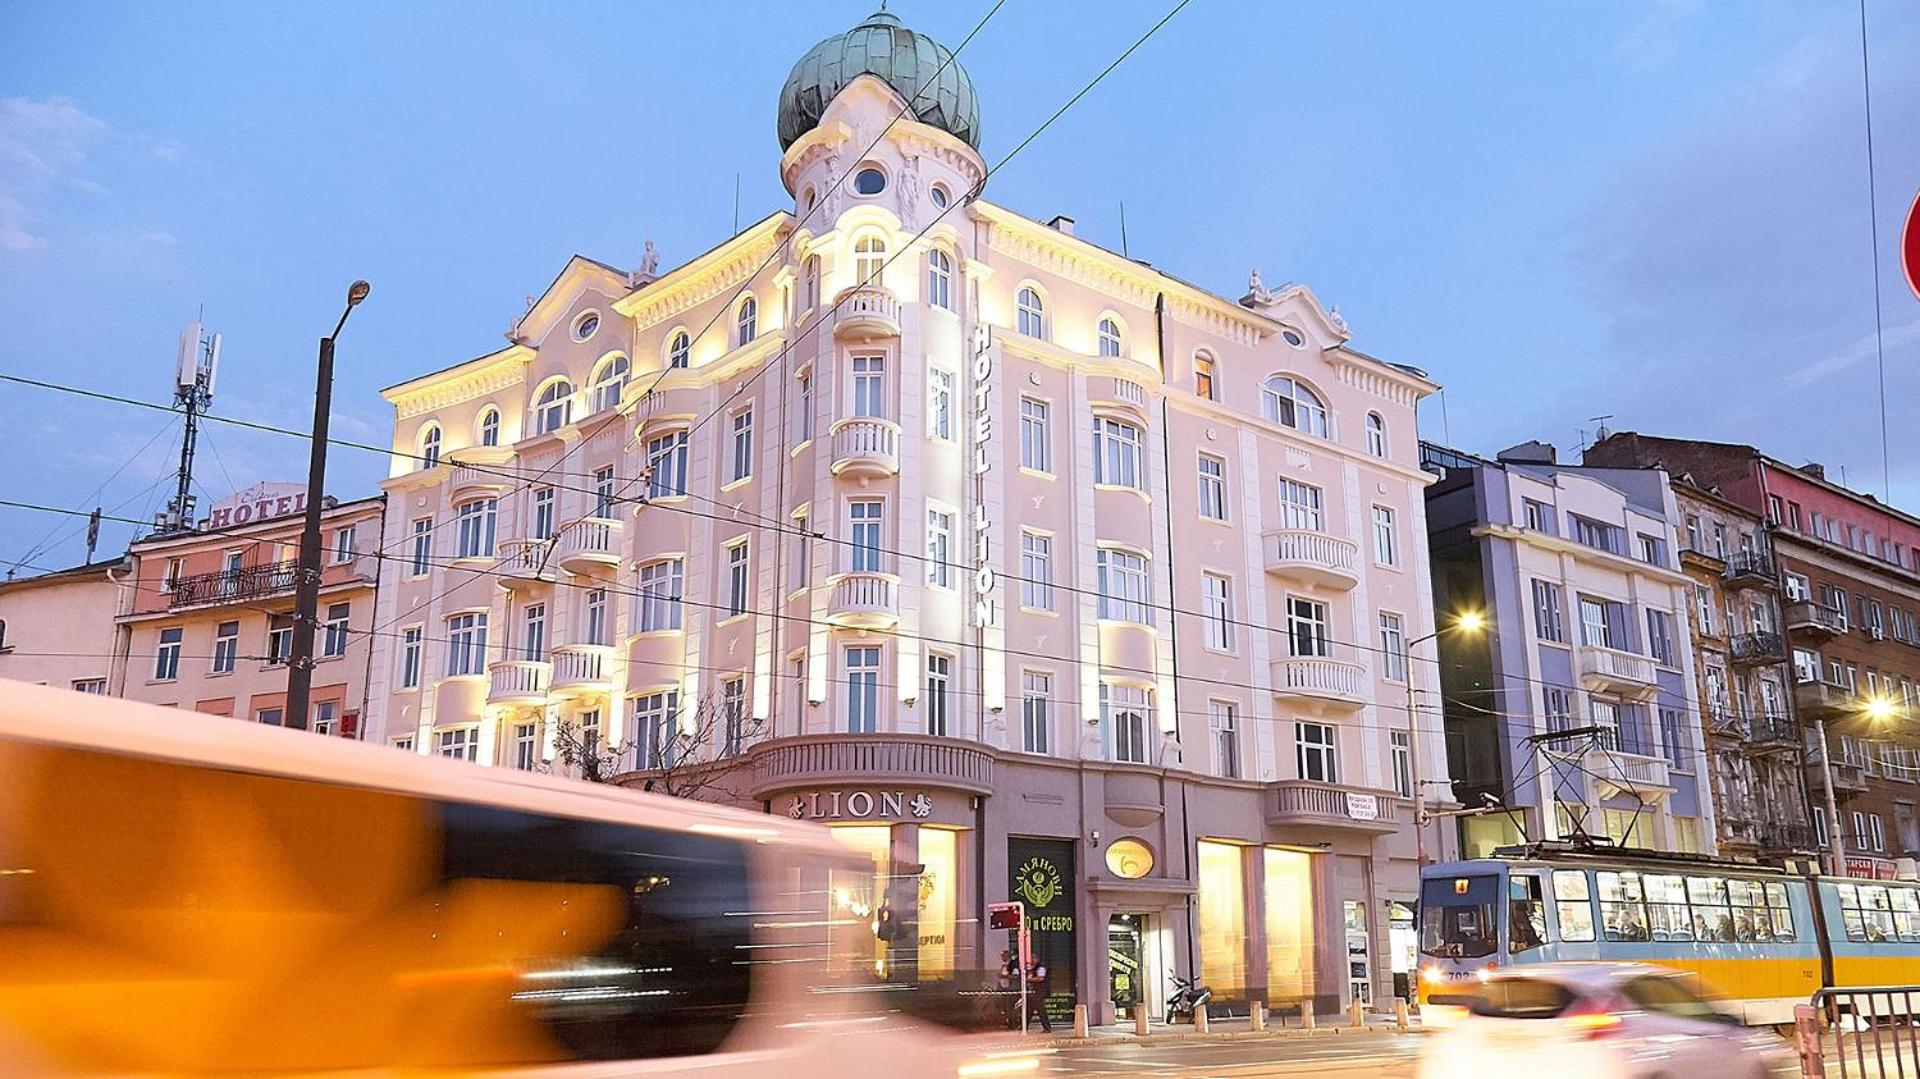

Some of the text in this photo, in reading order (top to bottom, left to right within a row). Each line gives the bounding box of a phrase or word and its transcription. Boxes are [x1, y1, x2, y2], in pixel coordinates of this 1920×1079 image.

[974, 324, 995, 630] HOTEL LION
[211, 493, 306, 529] HOTEL
[808, 791, 904, 818] LION
[1041, 916, 1073, 931] СРЕБРО
